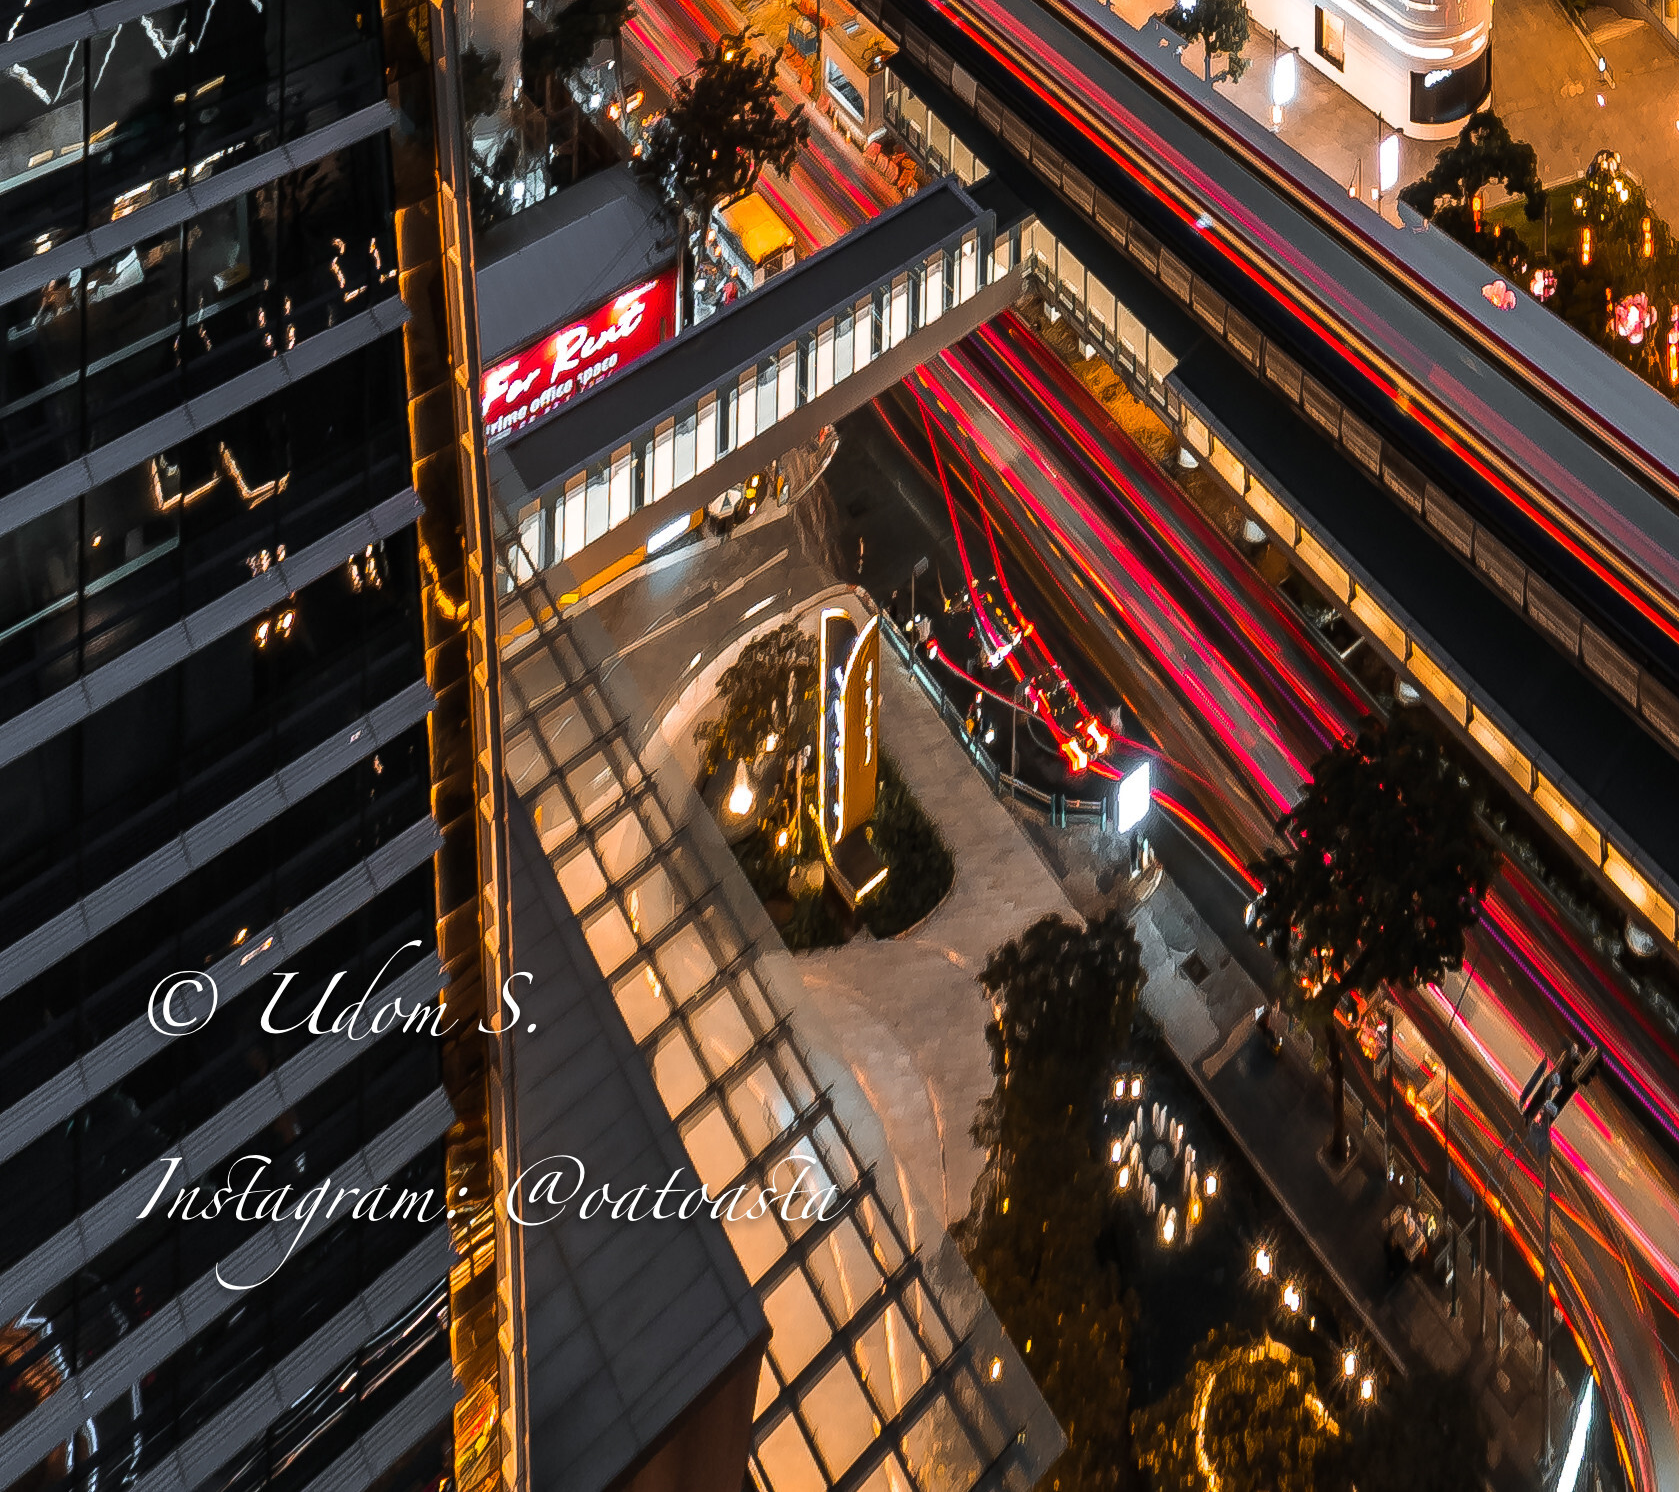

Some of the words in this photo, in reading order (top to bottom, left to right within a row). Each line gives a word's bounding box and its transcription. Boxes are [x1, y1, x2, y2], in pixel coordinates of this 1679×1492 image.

[481, 360, 541, 417] For
[549, 300, 646, 385] Rent
[485, 405, 528, 436] rime
[530, 379, 574, 414] office
